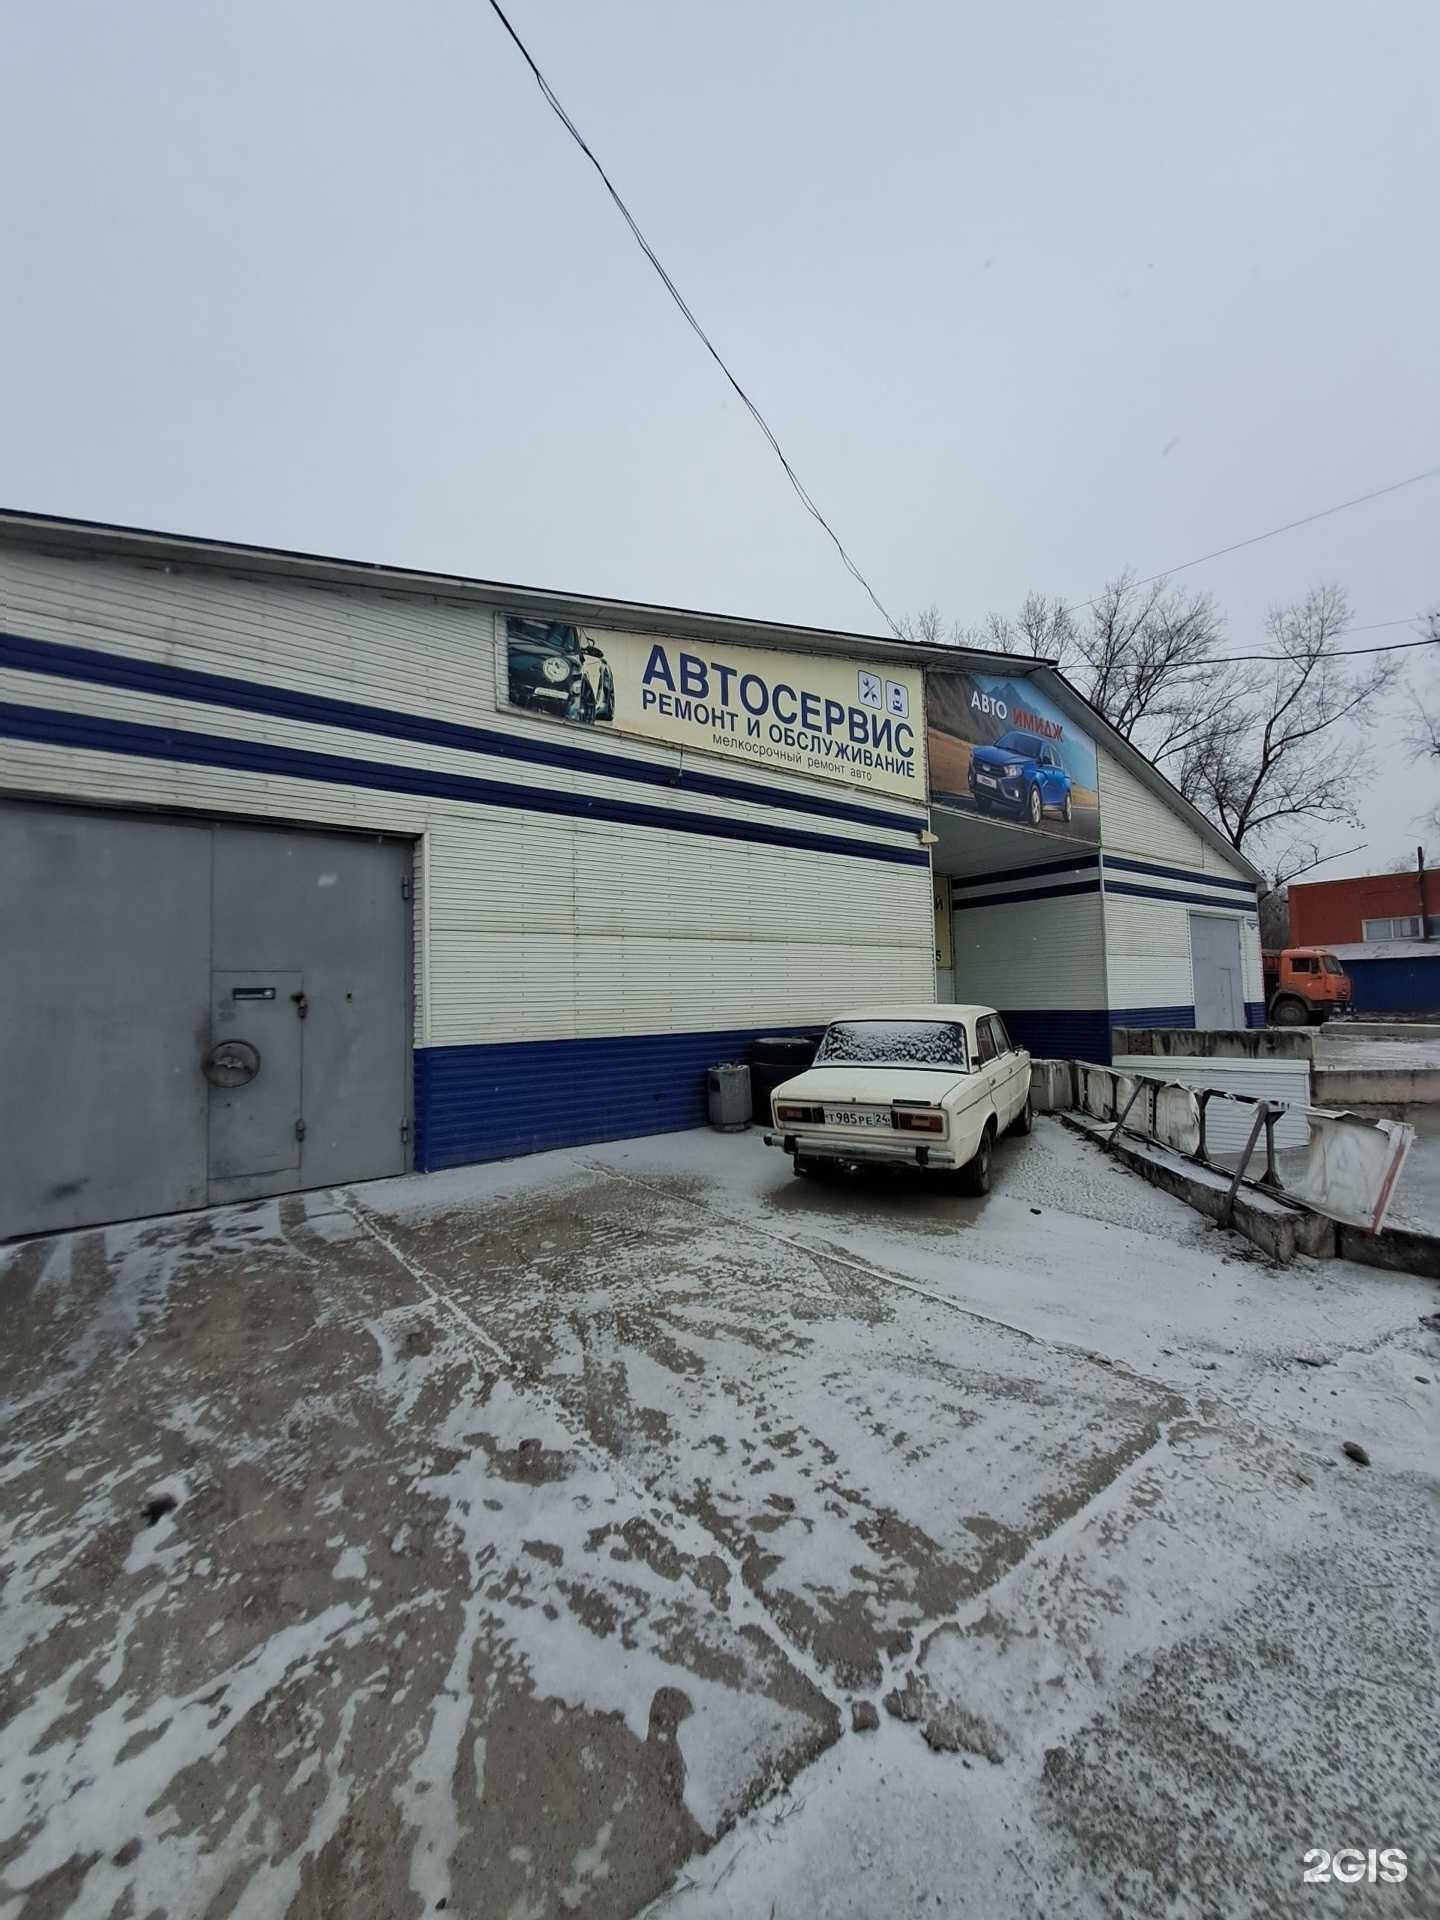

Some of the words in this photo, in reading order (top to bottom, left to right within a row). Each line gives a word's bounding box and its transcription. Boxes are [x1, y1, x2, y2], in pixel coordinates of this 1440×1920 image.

[642, 644, 915, 758] АВТОСЕРВИС
[642, 688, 739, 730] РЕМОНТ
[747, 718, 761, 739] И
[768, 724, 916, 778] ОБСЛУЖИВАНИЕ
[970, 690, 1008, 720] АВТО
[1011, 707, 1063, 741] ИМИДЖ
[712, 733, 802, 765] мелкосрочный
[807, 756, 845, 777] ремонт
[849, 767, 872, 782] авто
